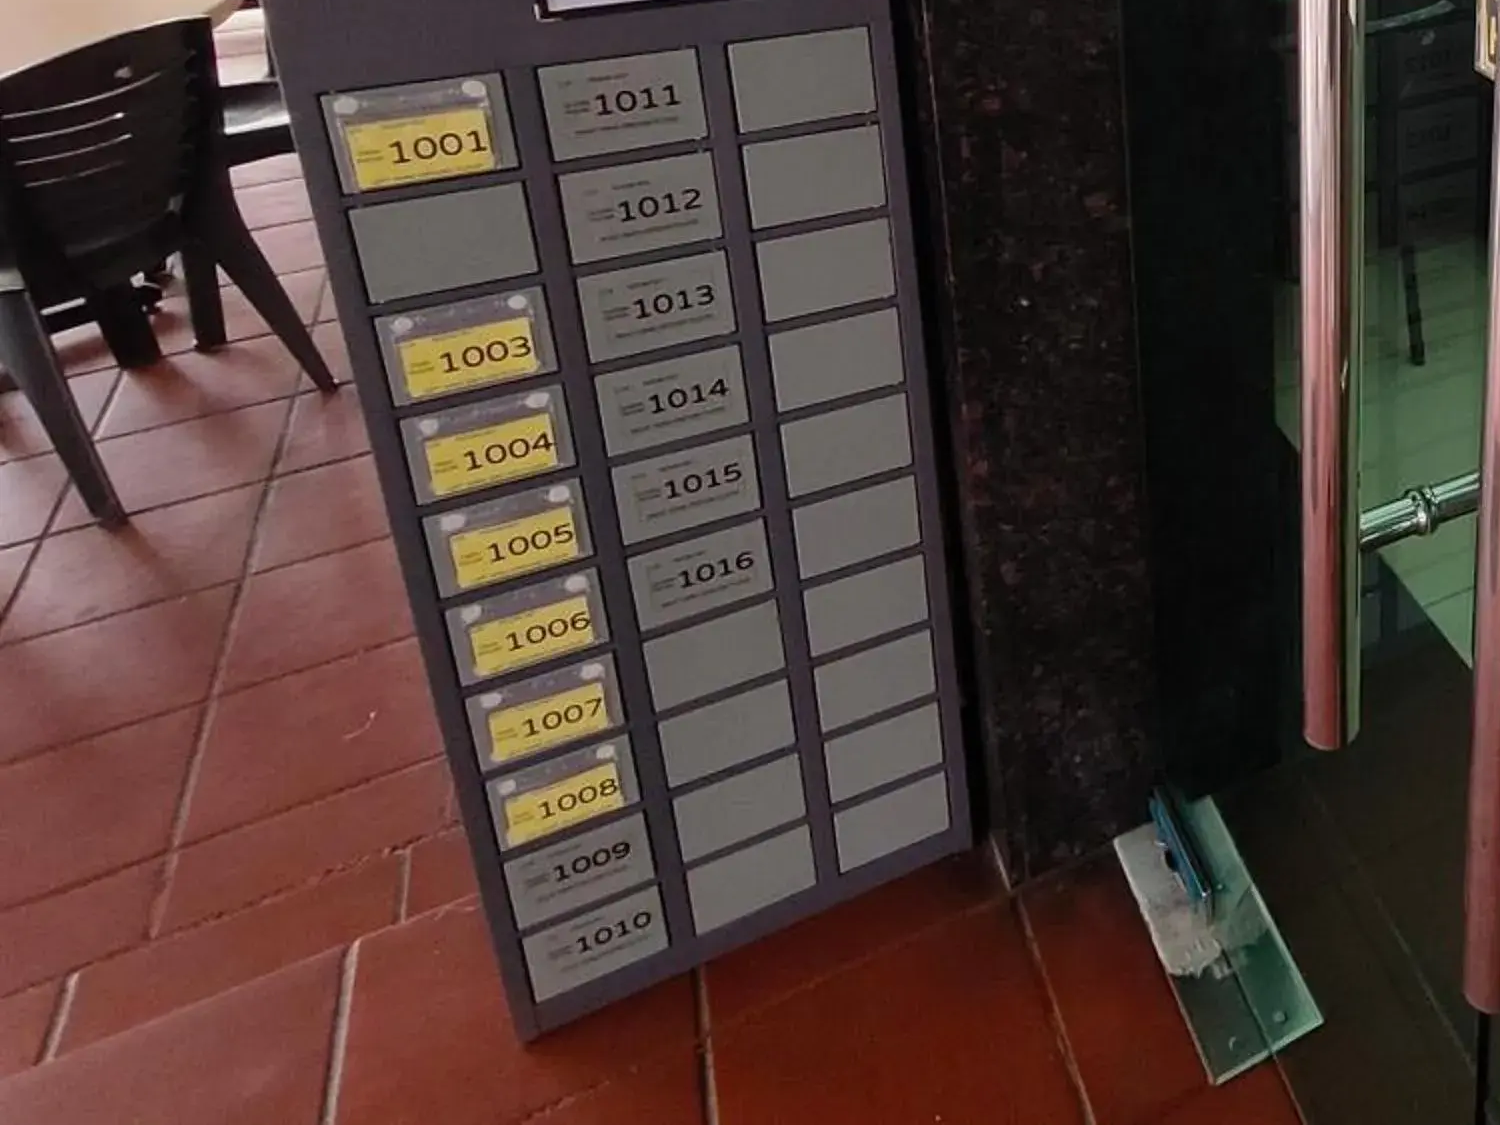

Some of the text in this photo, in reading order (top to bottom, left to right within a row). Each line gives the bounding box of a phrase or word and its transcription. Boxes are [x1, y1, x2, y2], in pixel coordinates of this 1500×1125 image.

[595, 84, 682, 117] 1011
[388, 129, 488, 165] 1001
[617, 188, 703, 223] 1012
[633, 284, 715, 320] 1013
[439, 335, 532, 374] 1003
[648, 378, 729, 414] 1014
[463, 432, 556, 472] 1004
[664, 462, 743, 500] 1015
[487, 522, 575, 564] 1005
[677, 550, 755, 589] 1016
[505, 610, 591, 652] 1006
[522, 696, 603, 737] 1007
[537, 777, 620, 820] 1008
[552, 841, 631, 883] 1009
[574, 910, 652, 954] 1010
